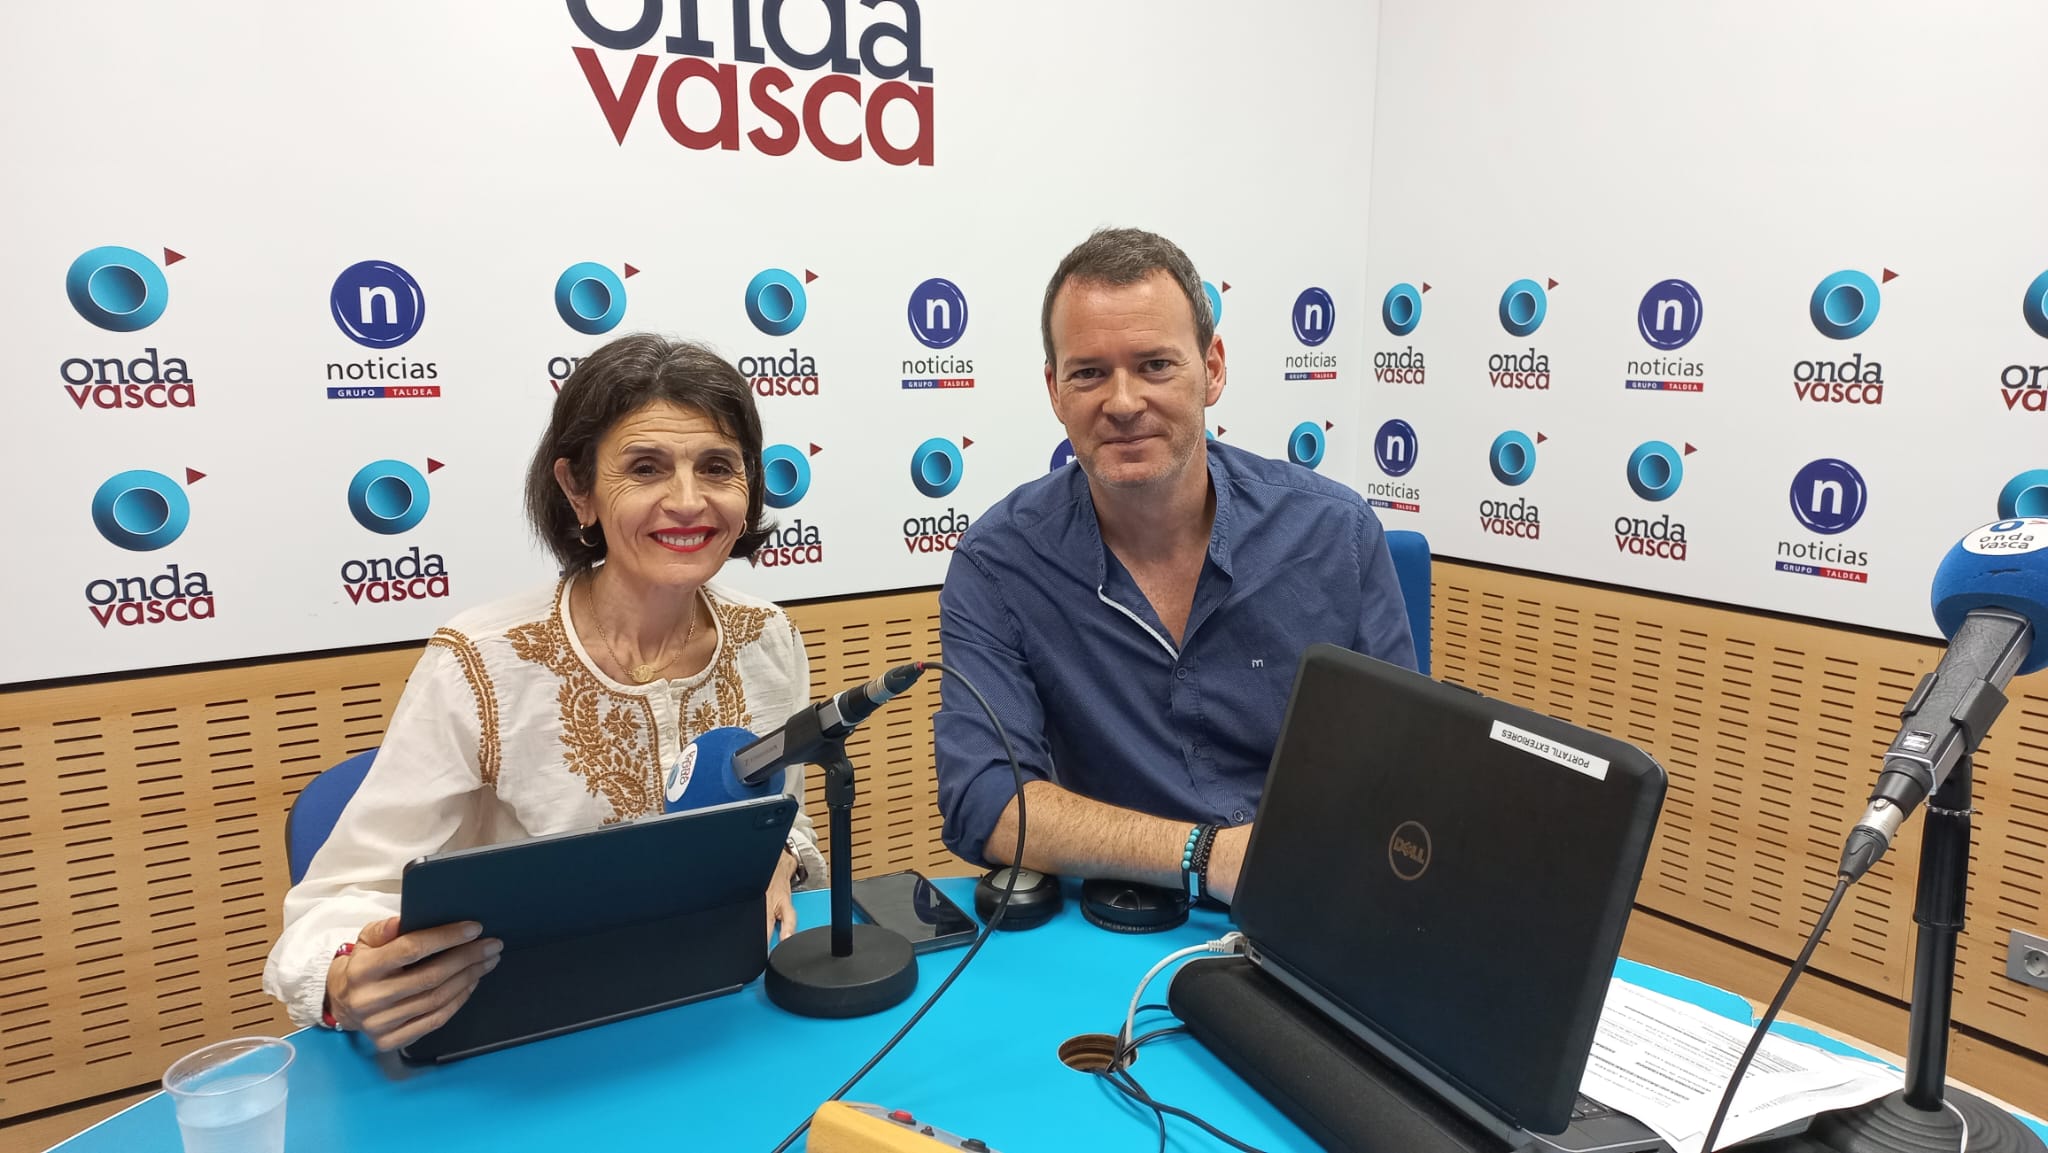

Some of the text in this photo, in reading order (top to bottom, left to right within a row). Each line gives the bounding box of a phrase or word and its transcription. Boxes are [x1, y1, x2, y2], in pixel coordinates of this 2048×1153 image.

[565, 0, 933, 83] onda
[571, 46, 934, 166] vasca
[359, 287, 397, 324] n
[926, 298, 949, 329] n
[1305, 304, 1323, 330] n
[1656, 299, 1683, 330] n
[60, 347, 193, 385] onda
[327, 357, 437, 380] noticias
[738, 348, 818, 377] onda
[902, 355, 973, 374] noticias
[1286, 352, 1336, 368] noticias
[1374, 345, 1425, 369] onda
[1488, 347, 1550, 373] onda
[1627, 357, 1704, 377] noticias
[1793, 353, 1883, 384] onda
[1375, 367, 1425, 384] vasca
[1490, 371, 1550, 390] vasca
[64, 382, 196, 409] vasca
[338, 387, 432, 398] GRUPO TALDEA
[1794, 381, 1884, 405] vasca
[1386, 435, 1404, 461] n
[1368, 482, 1420, 500] noticias
[1811, 479, 1842, 514] n
[903, 507, 969, 537] onda
[1480, 497, 1540, 523] onda
[763, 519, 822, 548] nda
[1481, 517, 1540, 540] vasca
[1615, 514, 1687, 543] onda
[1979, 533, 2034, 542] onda
[904, 533, 964, 554] vasc
[1616, 535, 1687, 561] vasca
[1777, 541, 1868, 566] noticias
[1980, 541, 2030, 549] vasca
[341, 546, 448, 583] onda
[1783, 563, 1861, 581] GRUPO TALDEA
[85, 563, 213, 605] onda
[344, 576, 449, 605] vasca
[89, 595, 215, 628] vasca
[1252, 659, 1264, 668] m
[1501, 729, 1590, 768] PORTATIL EXTERIORES
[1393, 836, 1425, 864] DELL
